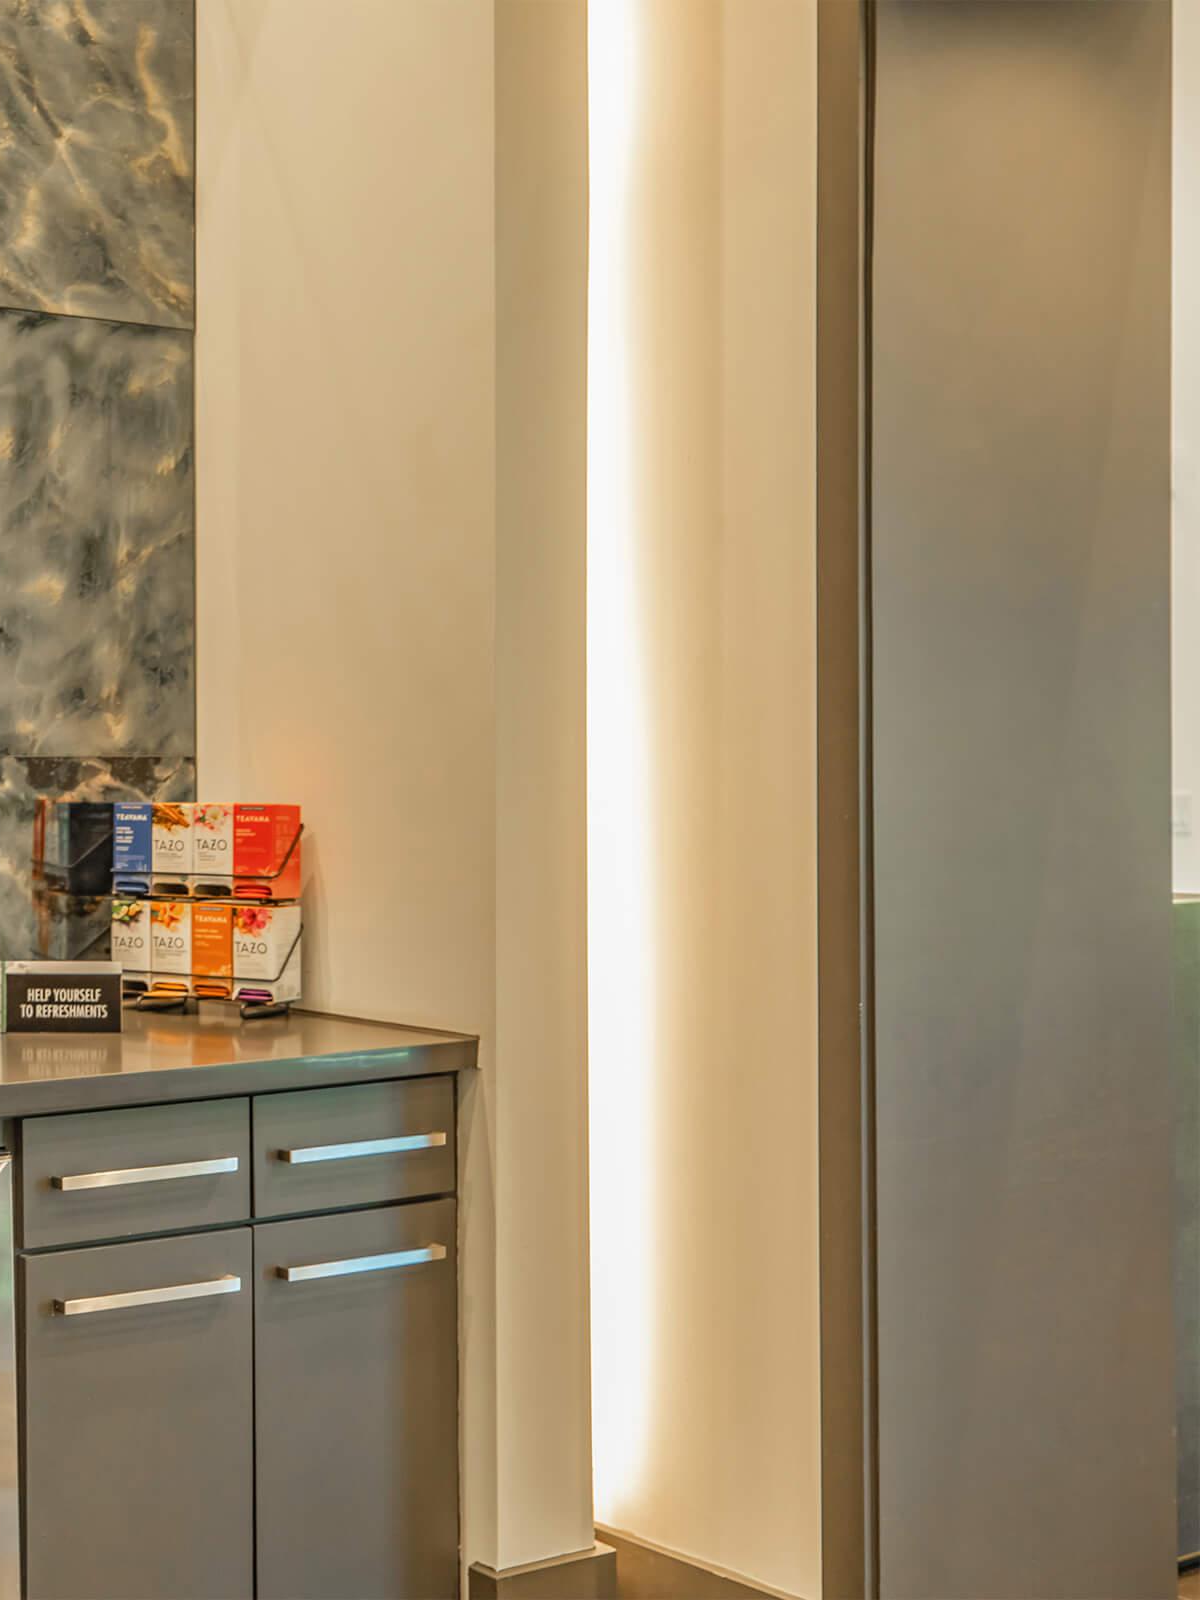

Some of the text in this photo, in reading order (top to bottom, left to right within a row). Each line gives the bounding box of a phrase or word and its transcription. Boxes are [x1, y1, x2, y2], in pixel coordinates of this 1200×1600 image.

[155, 839, 185, 852] TAZO
[196, 838, 227, 851] TAZO
[113, 936, 144, 949] TAZO
[153, 936, 184, 949] TAZO
[235, 941, 268, 954] TAZO
[27, 988, 102, 1003] HELP YOURSELF
[20, 1004, 109, 1018] TO REFRESHMENTS
